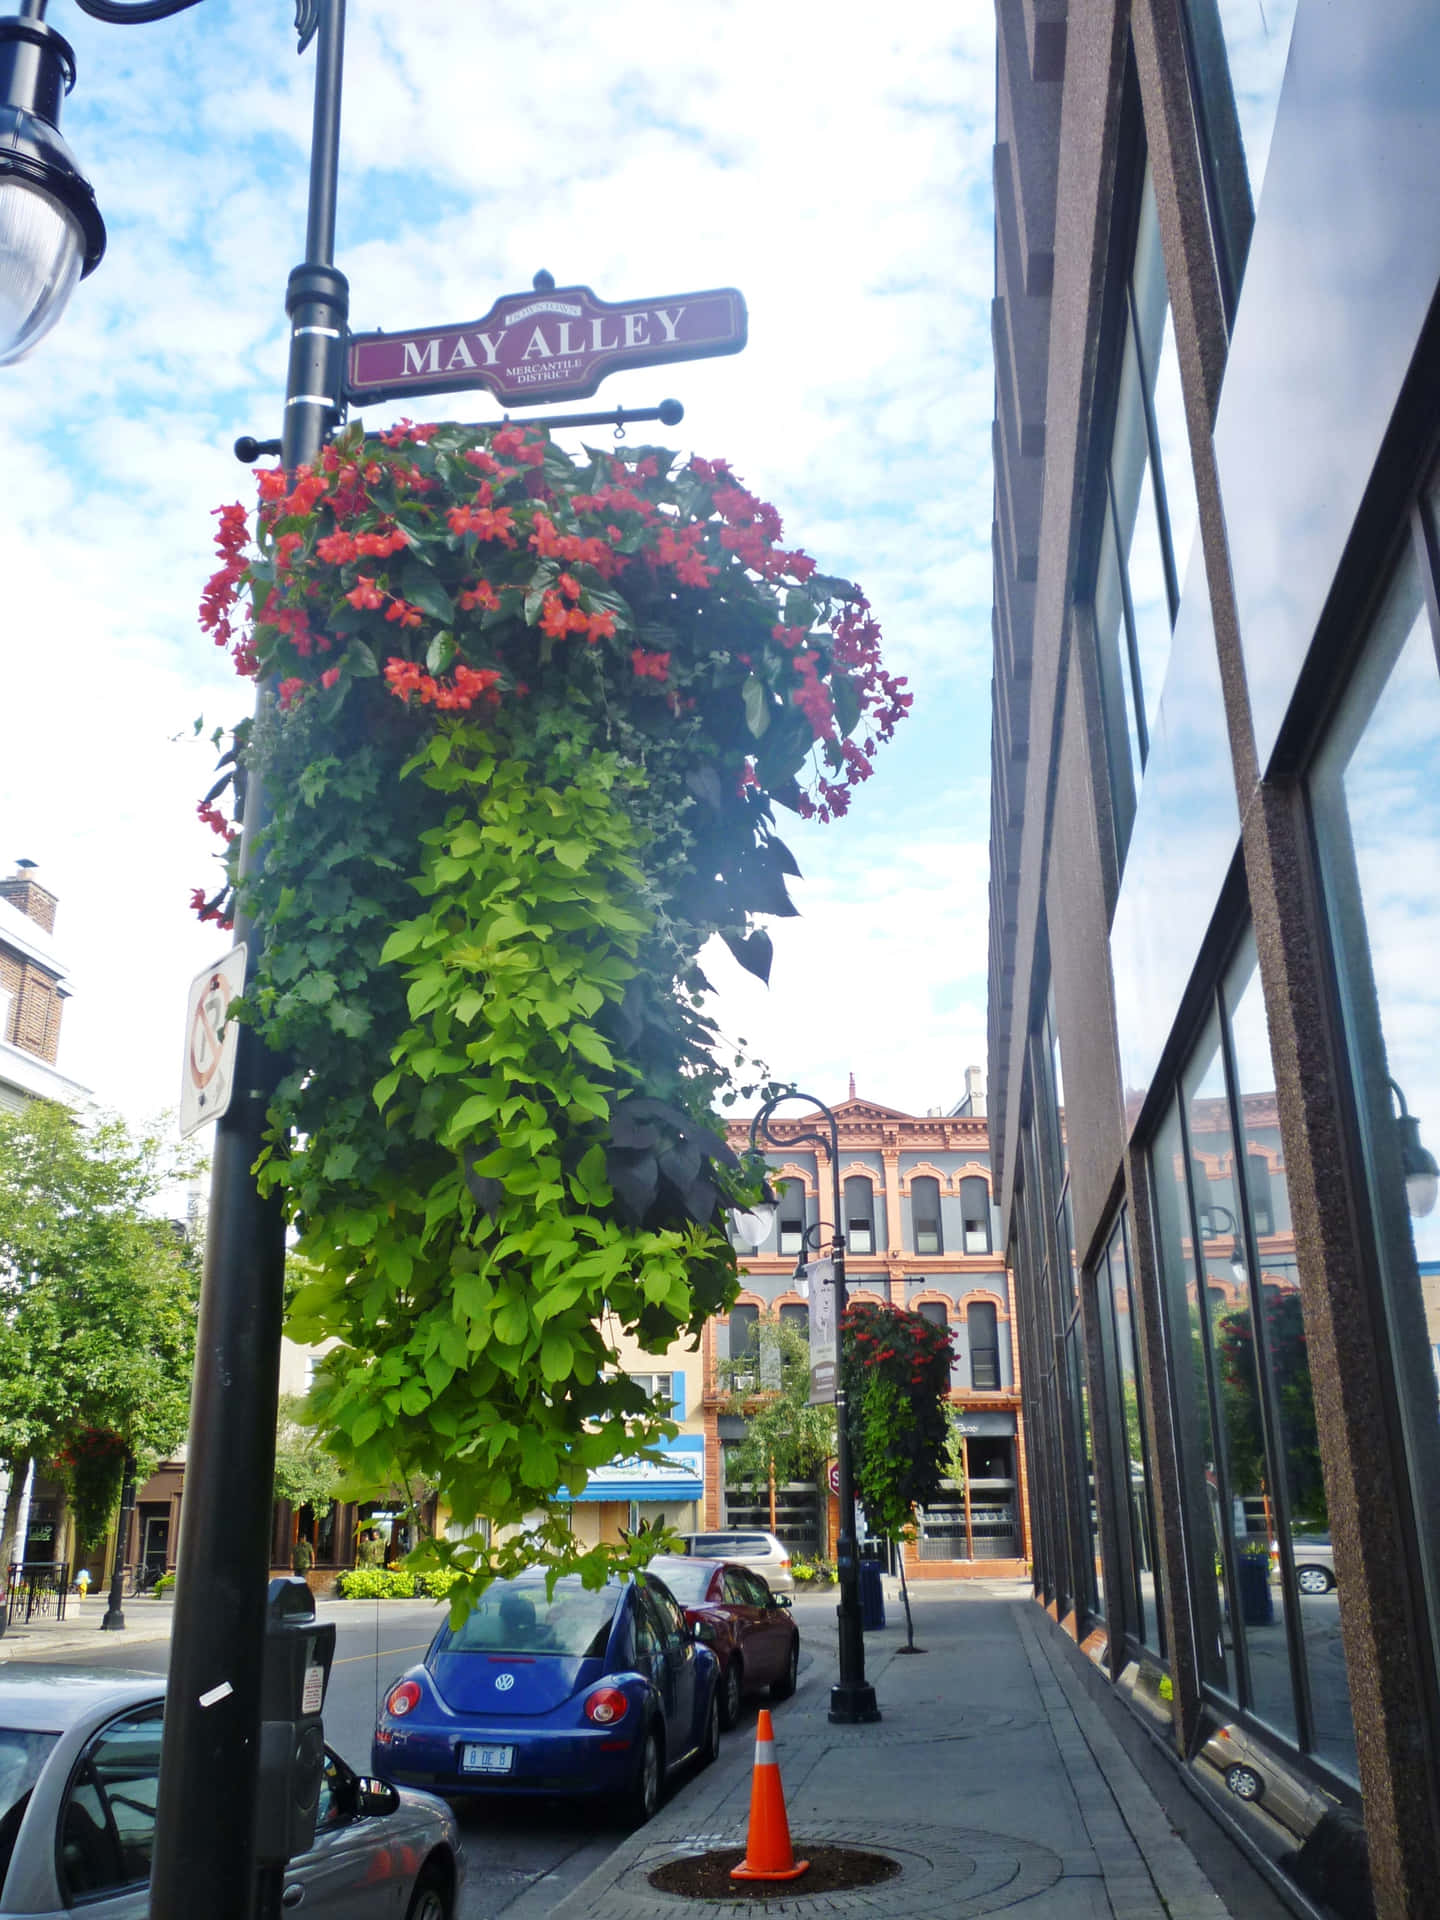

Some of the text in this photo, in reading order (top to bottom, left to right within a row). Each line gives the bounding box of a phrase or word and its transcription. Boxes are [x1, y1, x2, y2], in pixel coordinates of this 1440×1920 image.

[401, 307, 688, 375] MAY ALLEY
[506, 359, 583, 377] MERCANTILE
[517, 370, 570, 383] DISTRICT
